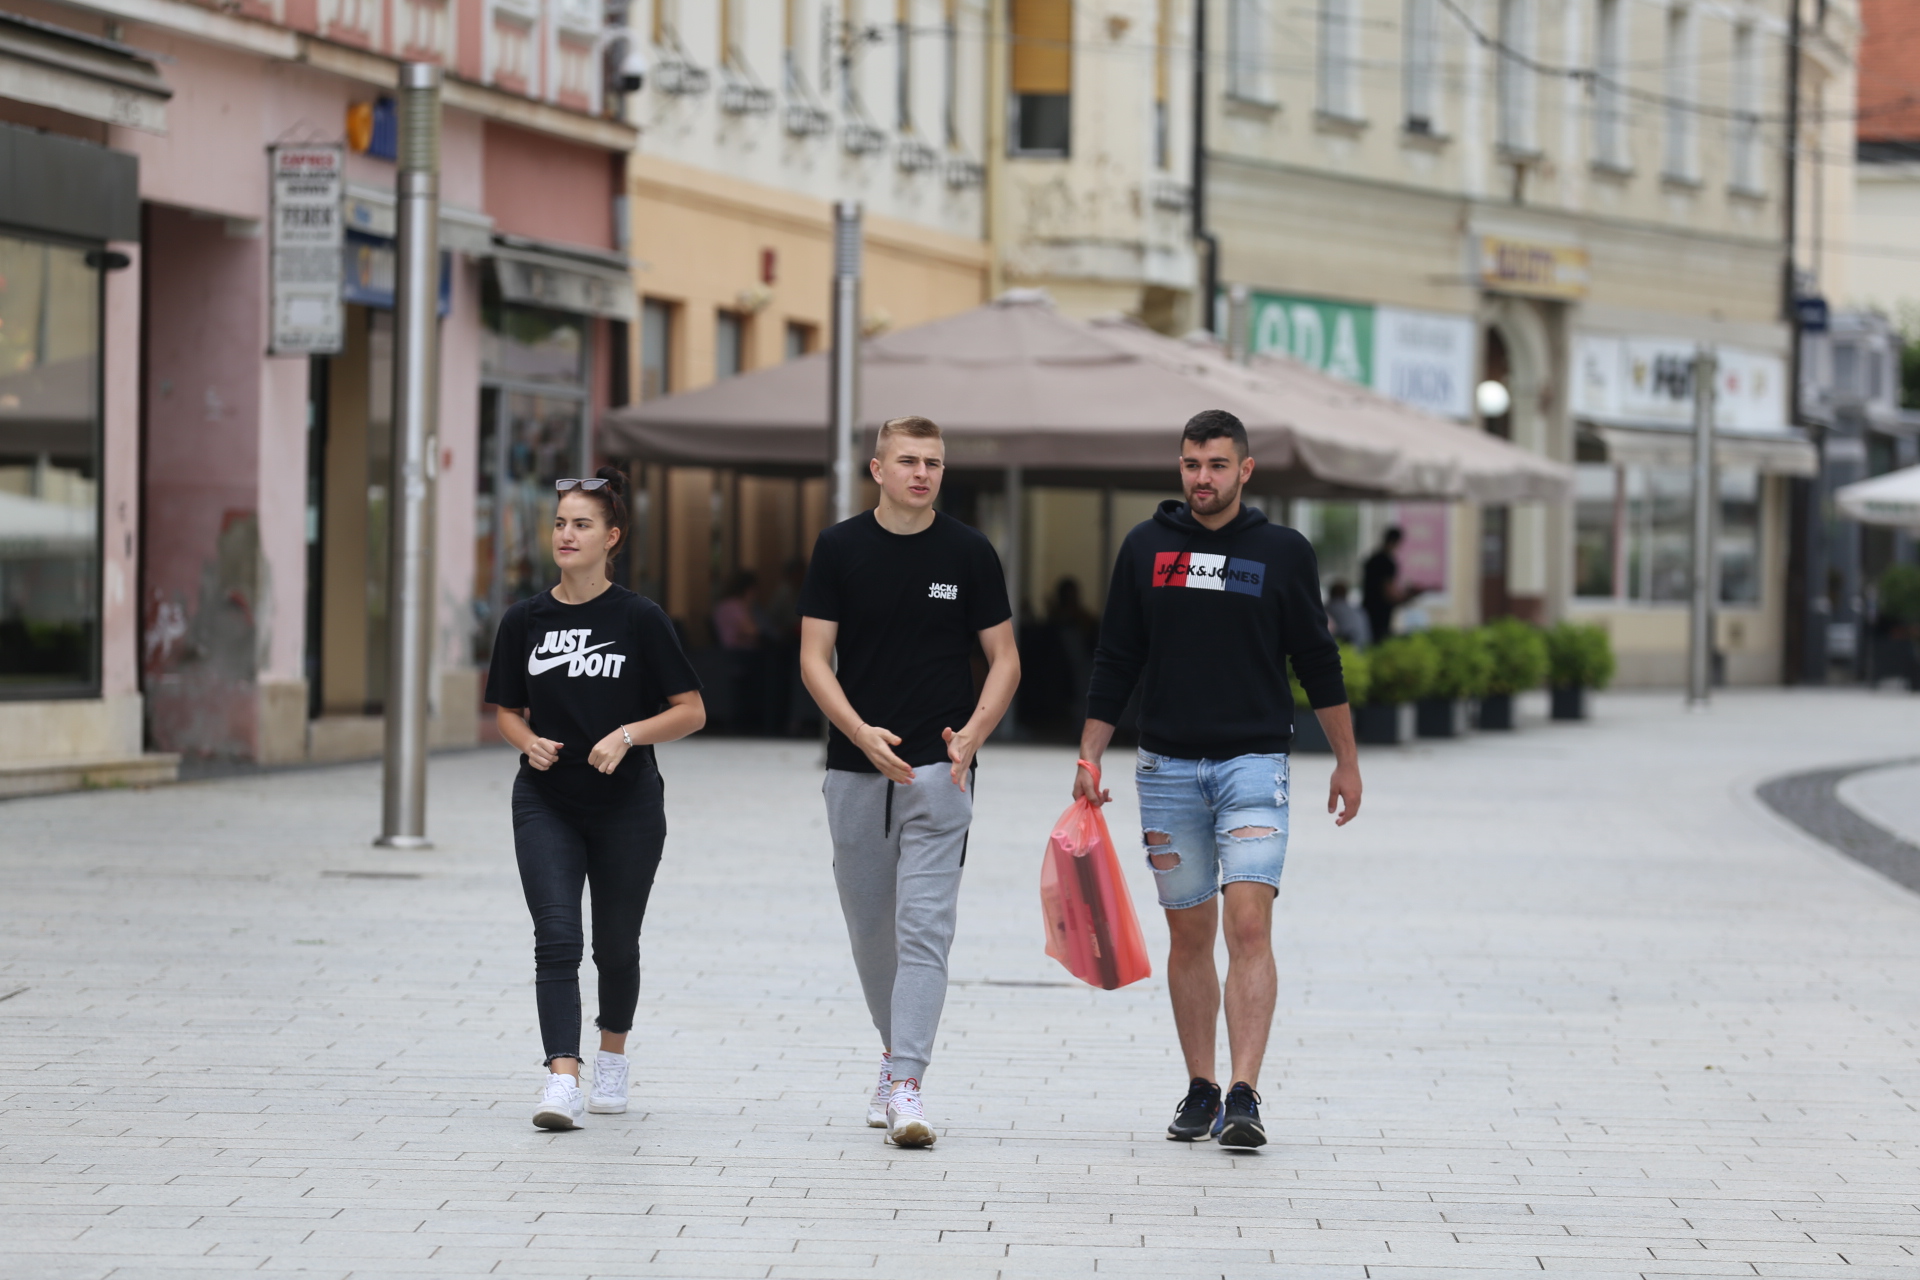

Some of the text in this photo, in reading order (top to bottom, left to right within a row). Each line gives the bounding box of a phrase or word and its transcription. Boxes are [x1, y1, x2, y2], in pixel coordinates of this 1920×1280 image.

[928, 582, 958, 593] JACK&
[928, 590, 957, 600] JONES
[537, 628, 592, 654] JUST
